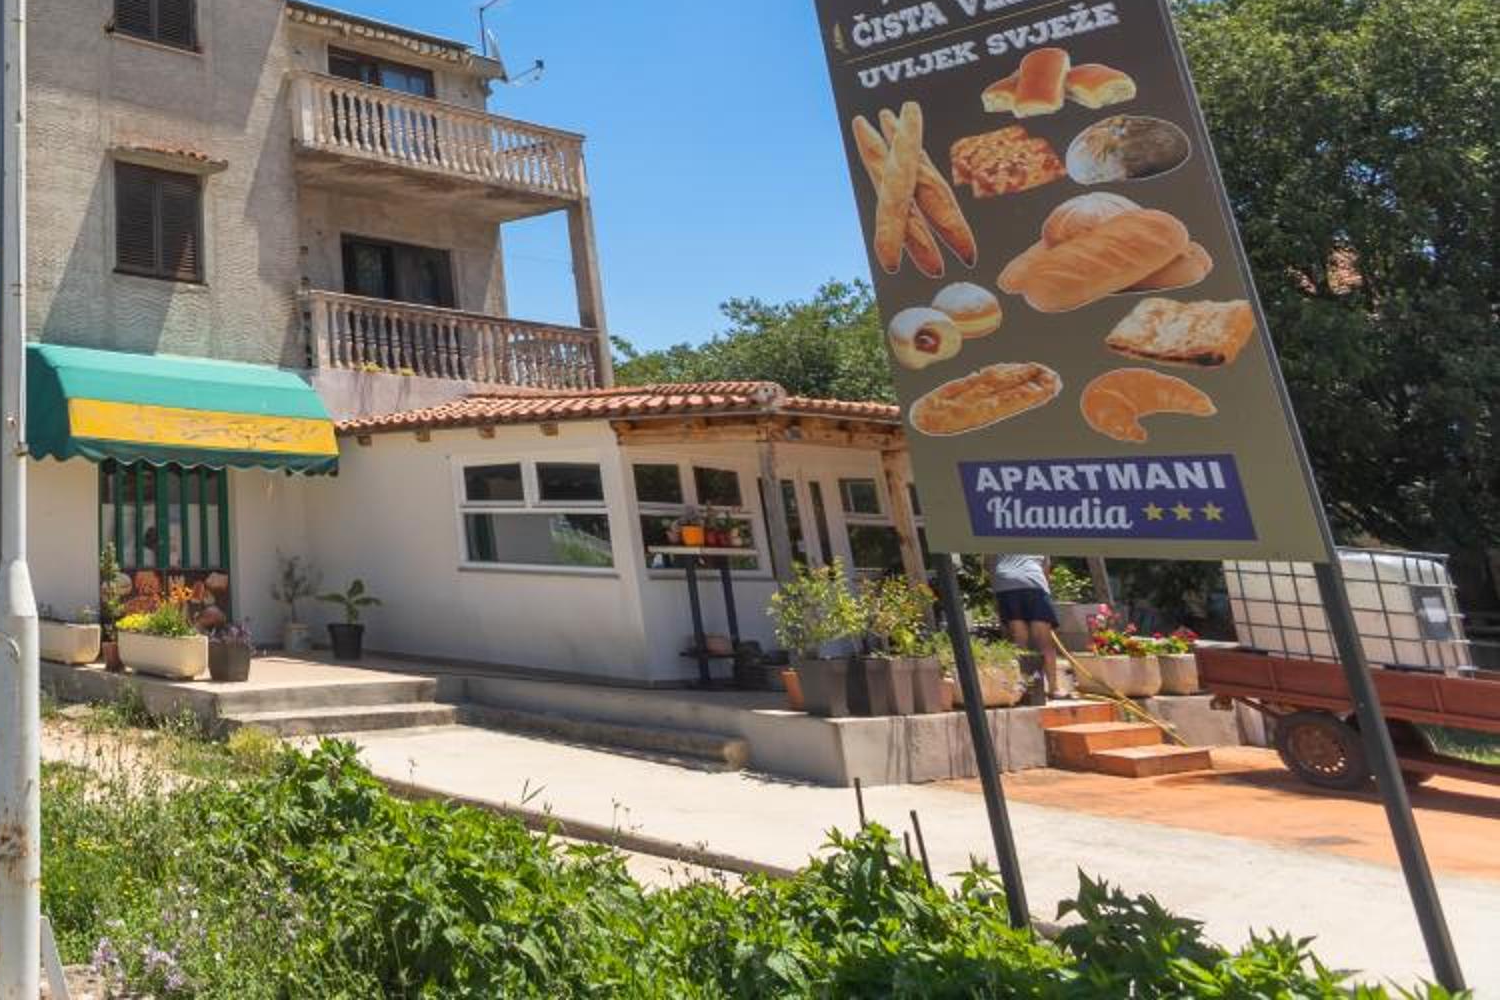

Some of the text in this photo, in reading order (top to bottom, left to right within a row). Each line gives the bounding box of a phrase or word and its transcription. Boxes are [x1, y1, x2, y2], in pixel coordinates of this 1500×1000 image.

[853, 2, 948, 48] ČISTA
[859, 2, 1119, 88] UVIJEK SVJEŽE
[976, 461, 1226, 492] APARTMANI
[987, 497, 1133, 529] Klaudia
